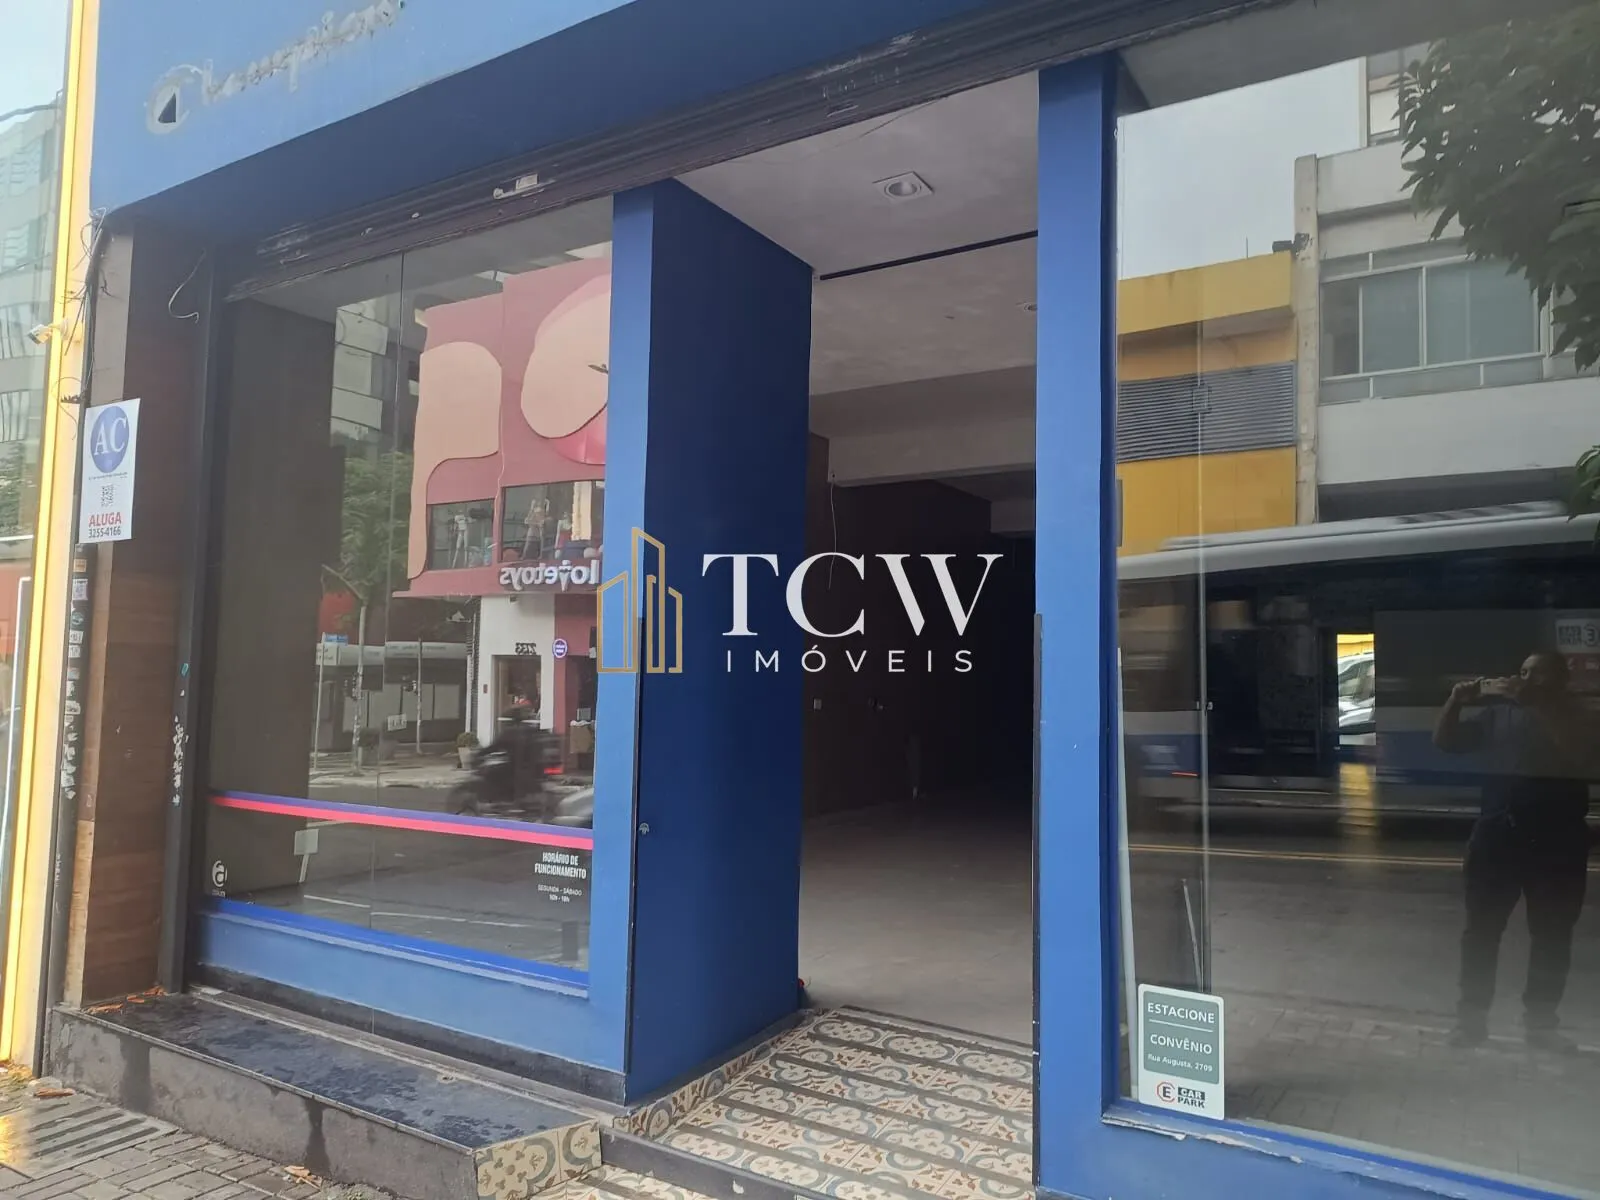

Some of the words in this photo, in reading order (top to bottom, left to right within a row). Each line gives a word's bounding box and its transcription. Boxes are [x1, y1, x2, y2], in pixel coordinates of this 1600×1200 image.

[93, 416, 127, 456] AC
[88, 511, 122, 528] ALUGA
[542, 851, 570, 865] HORÁRIO
[570, 855, 579, 866] DE
[534, 863, 587, 880] FUNCIONAMENTO
[1147, 1002, 1215, 1024] ESTACIONE
[1150, 1033, 1213, 1055] CONVÊNIO
[1147, 1053, 1161, 1062] Rua
[1194, 1064, 1213, 1072] 2709
[1179, 1087, 1204, 1100] CAR
[1177, 1096, 1206, 1109] PARK
